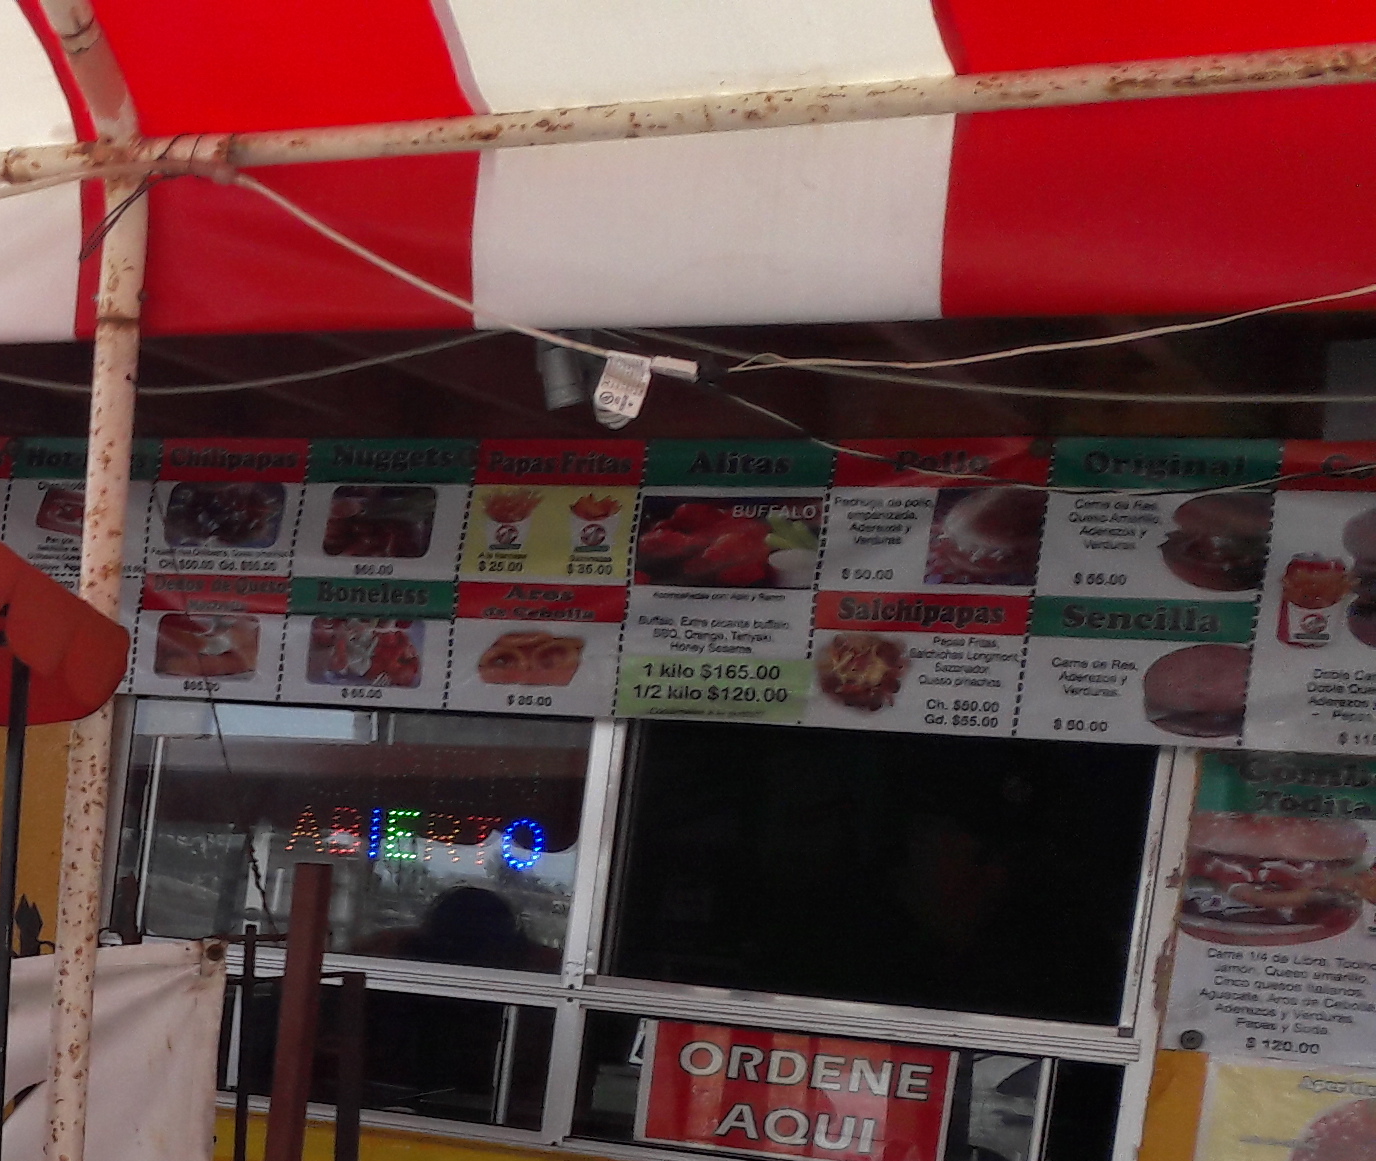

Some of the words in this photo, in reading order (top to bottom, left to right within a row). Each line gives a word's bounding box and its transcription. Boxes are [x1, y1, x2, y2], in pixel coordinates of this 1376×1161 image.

[332, 445, 454, 471] Nuggets
[487, 451, 556, 475] Papas
[560, 451, 633, 475] Fritas
[687, 450, 793, 475] Alitas
[896, 450, 991, 473] Pollo
[1082, 450, 1247, 481] Original
[731, 504, 818, 519] BUFFALO
[1073, 572, 1081, 585] $
[316, 581, 429, 605] Boneless
[503, 585, 574, 601] Aros
[838, 597, 1007, 628] Salchipapas
[1061, 604, 1221, 633] Sencilla
[642, 662, 653, 677] 1
[660, 663, 695, 678] kilo
[700, 664, 780, 680] $165.00
[633, 684, 663, 700] 1/2
[668, 685, 702, 700] kilo
[707, 686, 789, 703] $120.00
[1053, 719, 1061, 731] $
[283, 803, 547, 871] ABIERTO
[1245, 1037, 1255, 1049] $
[678, 1040, 934, 1101] ORDENE
[714, 1103, 877, 1154] AQUI
